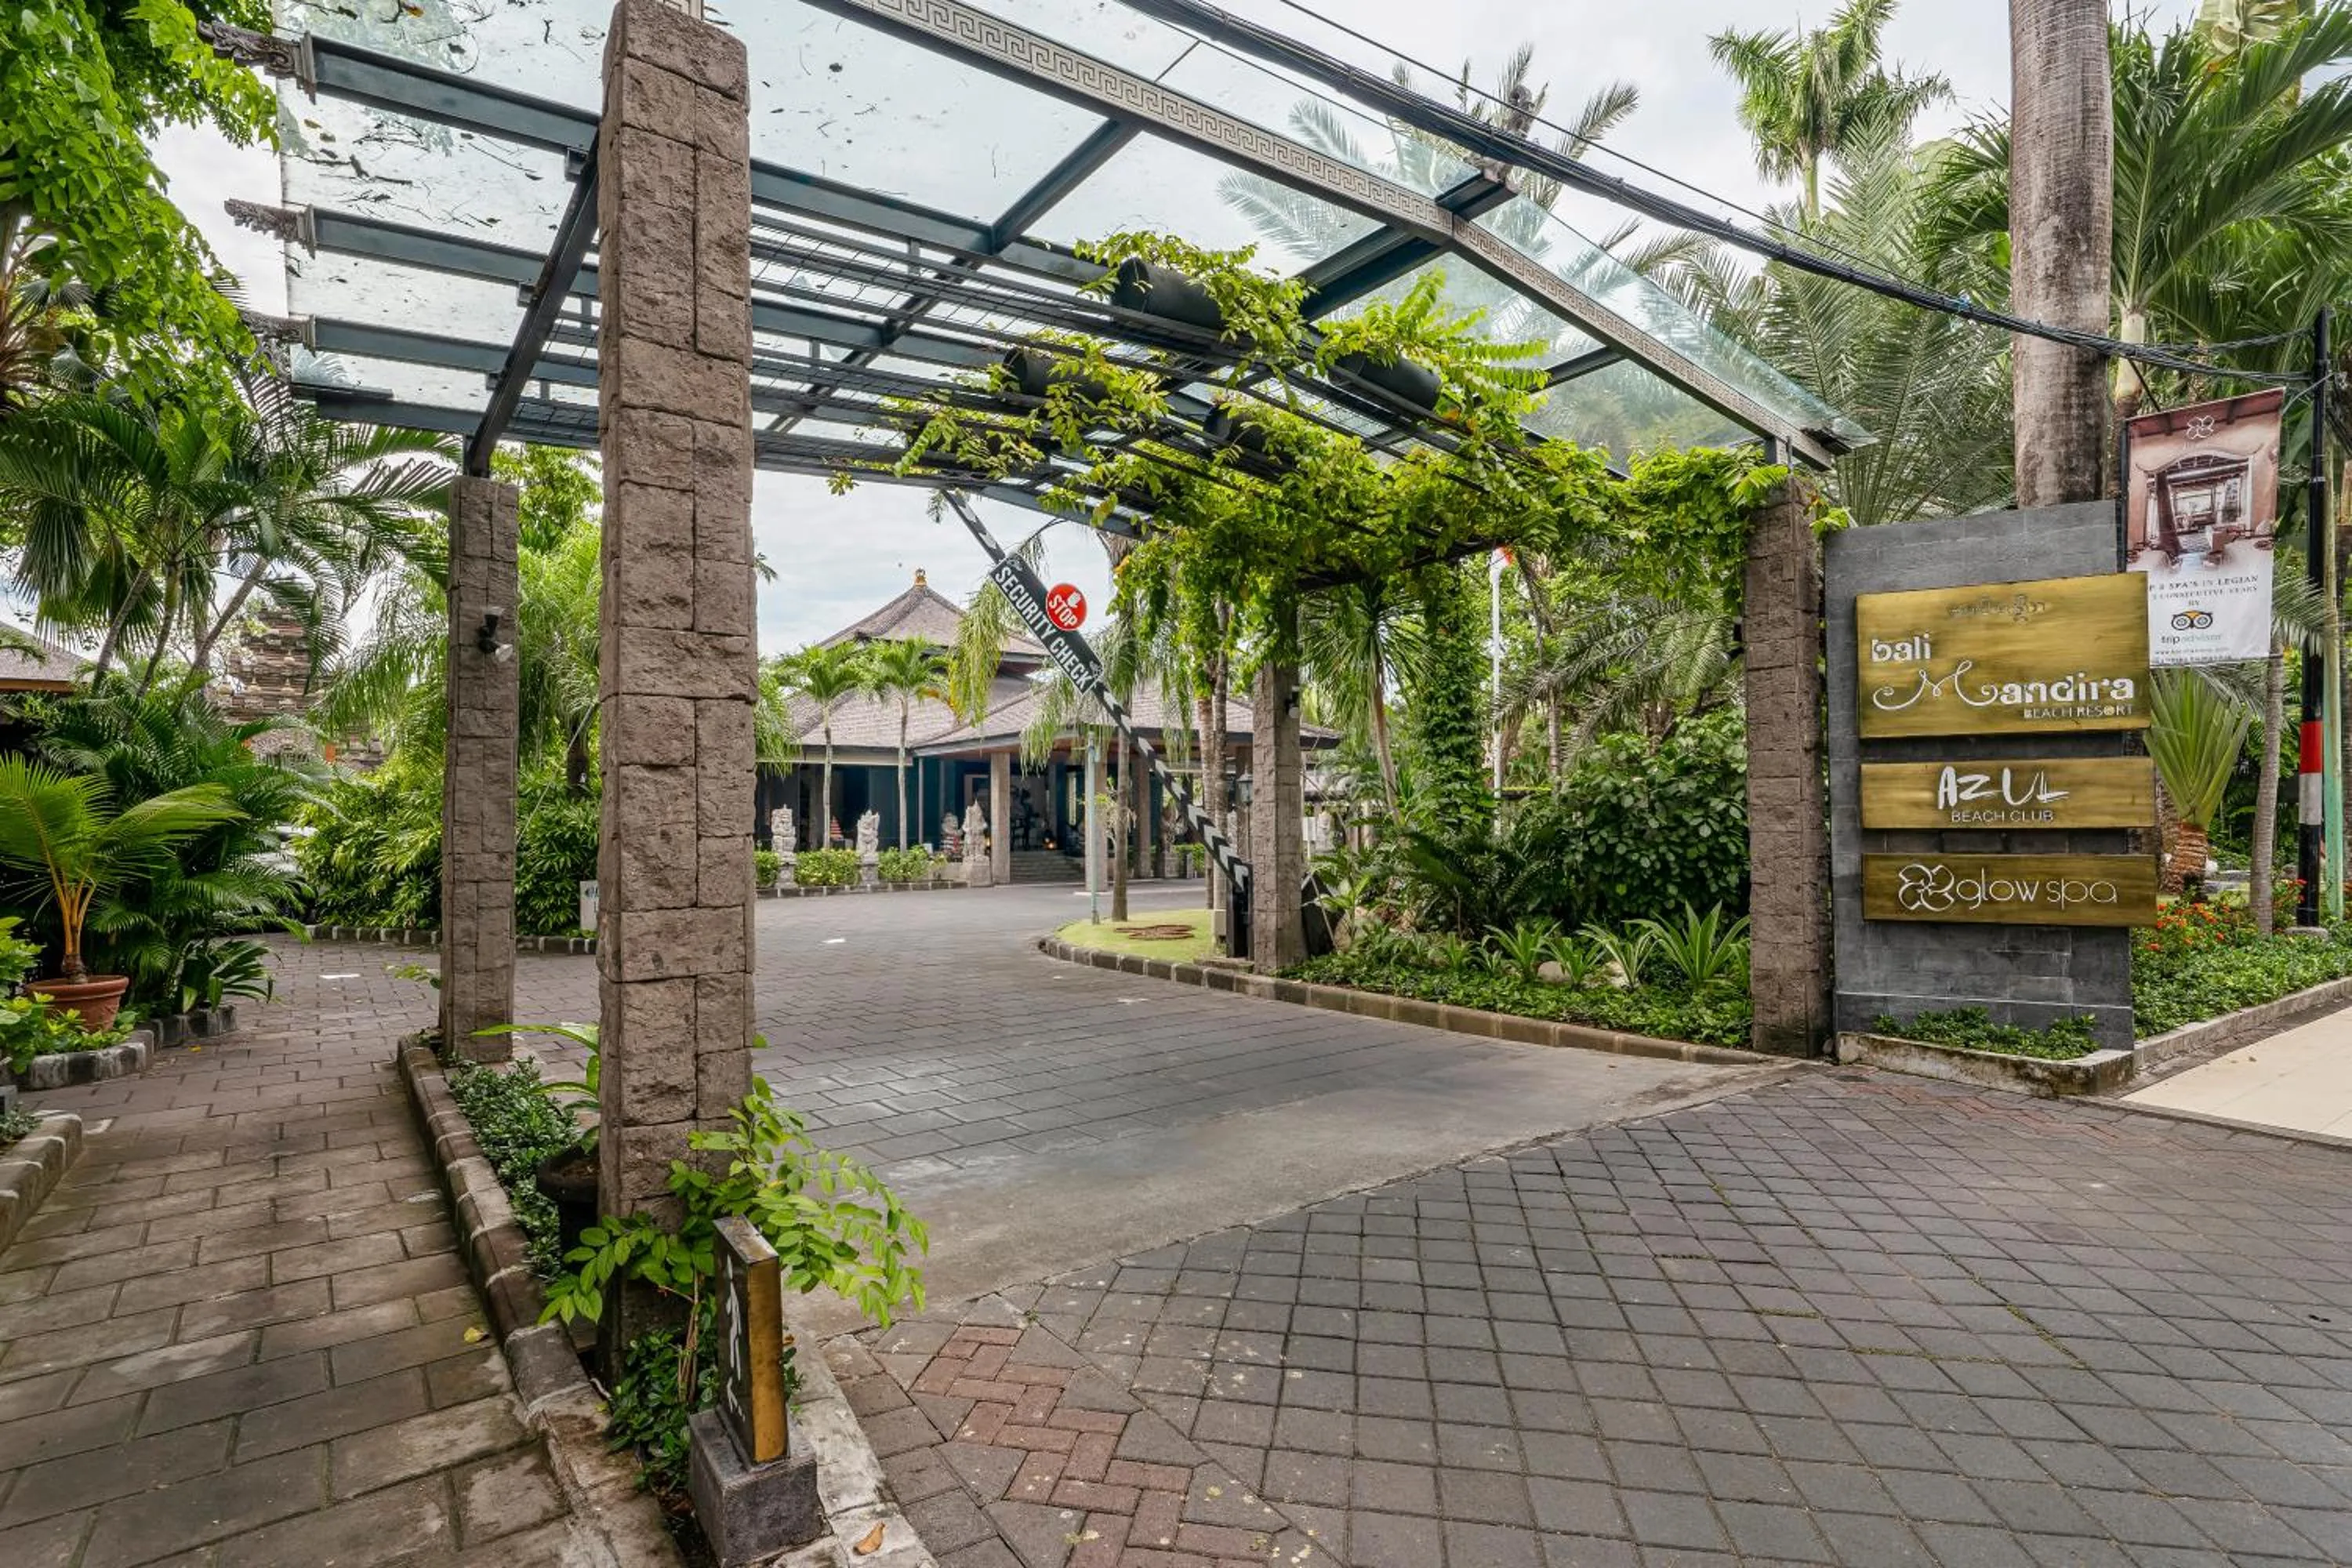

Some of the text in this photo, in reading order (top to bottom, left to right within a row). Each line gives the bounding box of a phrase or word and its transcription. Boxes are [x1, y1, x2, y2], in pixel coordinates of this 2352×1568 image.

[2218, 575, 2259, 586] LEGIAN
[1049, 594, 1078, 627] STOP
[995, 566, 1092, 689] SECURITY CHECK
[1871, 632, 1932, 662] bali
[1873, 659, 2135, 710] Mandira
[2024, 704, 2133, 719] BEACH RESORT
[1951, 809, 2054, 822] BEACH CLUB
[1956, 867, 2118, 910] glow spa
